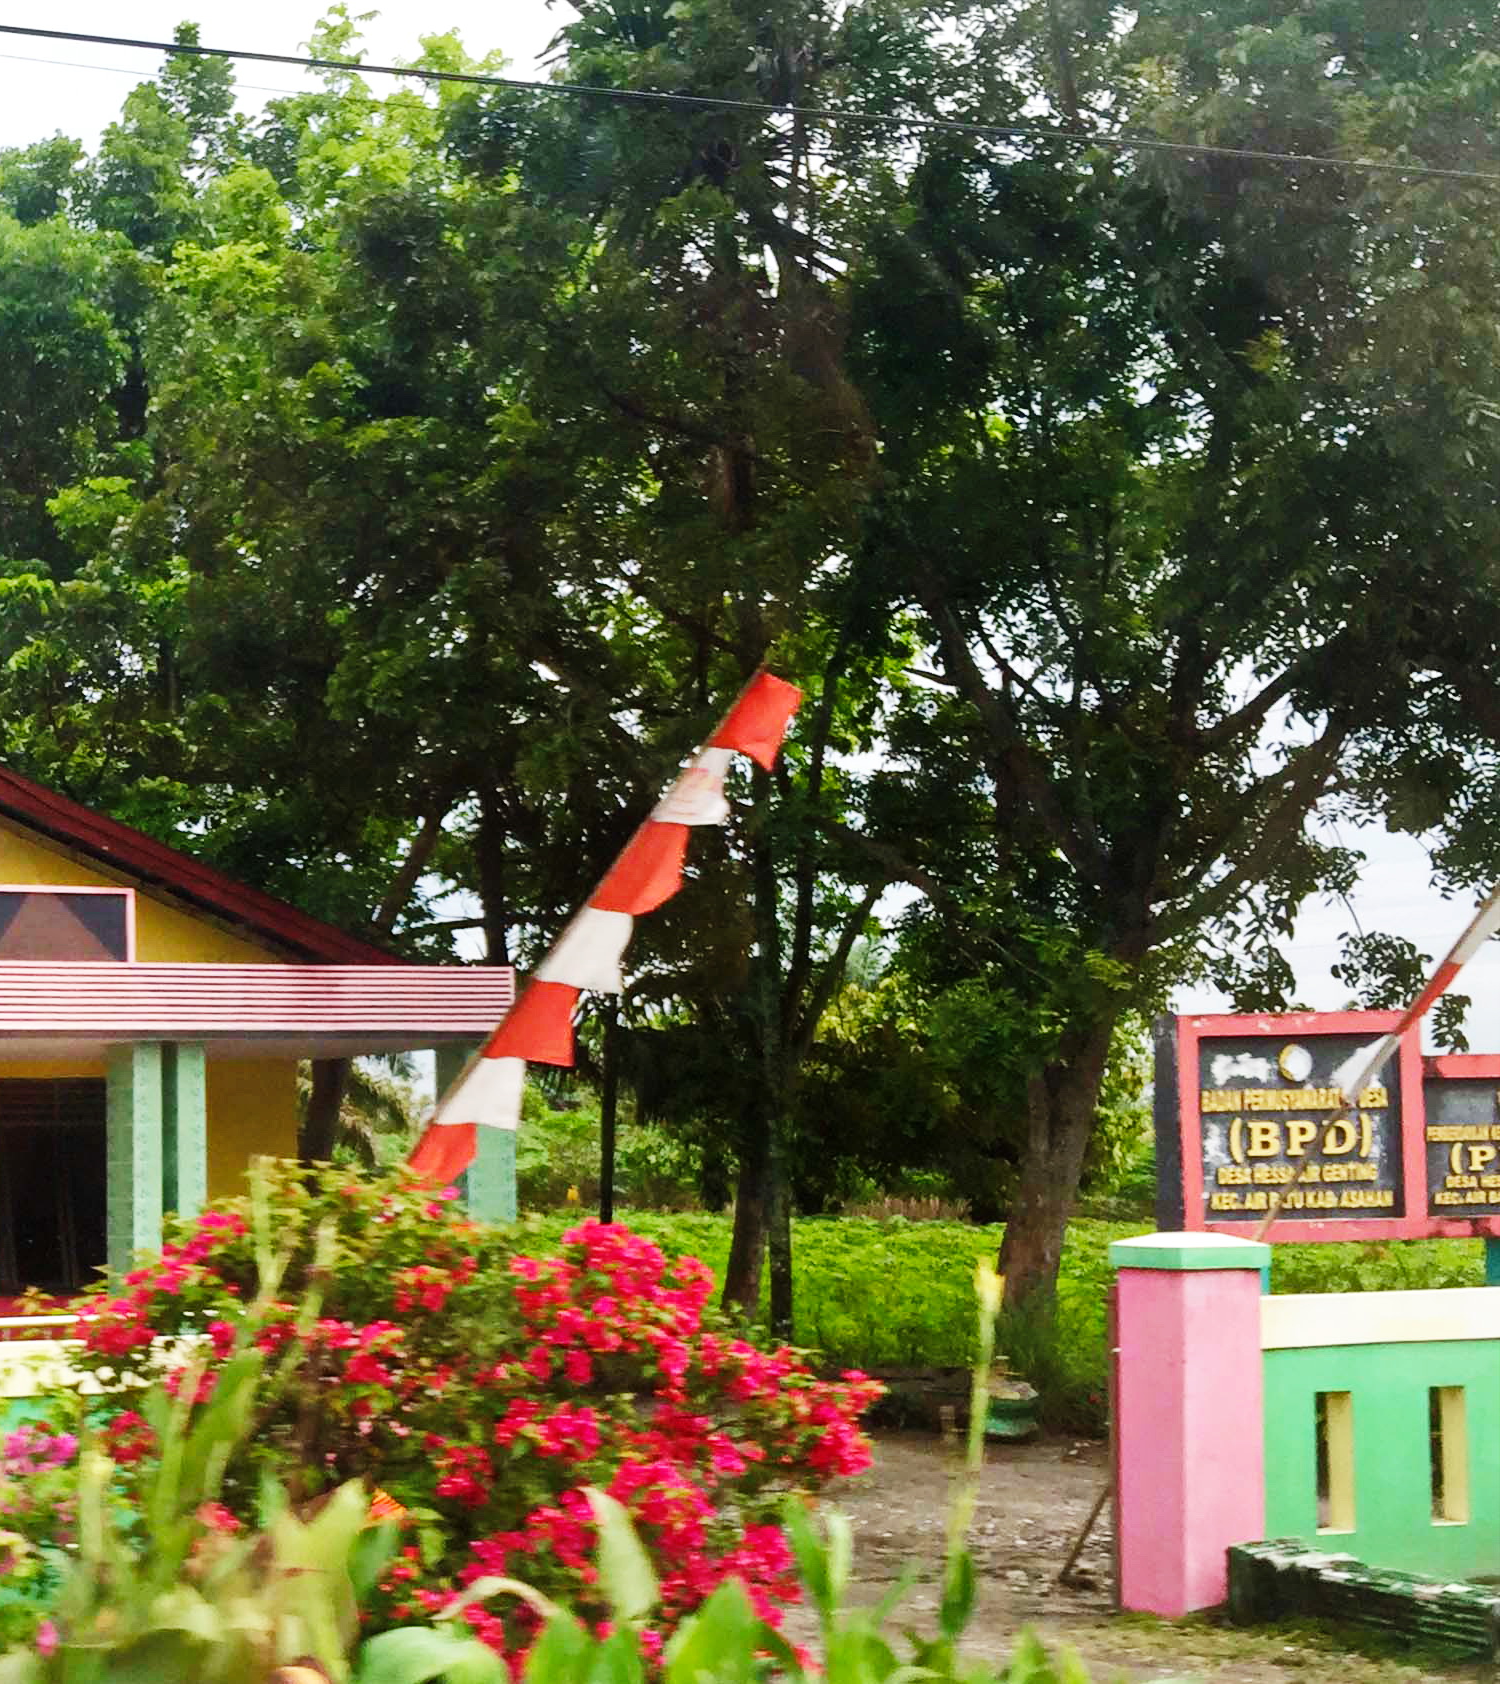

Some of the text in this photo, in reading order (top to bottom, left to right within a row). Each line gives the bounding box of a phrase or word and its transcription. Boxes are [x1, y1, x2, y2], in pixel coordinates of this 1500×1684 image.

[1201, 1090, 1242, 1112] BADAN
[1230, 1112, 1373, 1164] (BPD)
[1217, 1167, 1252, 1185] DESA
[1322, 1162, 1378, 1182] GENTING
[1445, 1174, 1478, 1189] DESA
[1244, 1191, 1268, 1210] AIR
[1340, 1189, 1394, 1208] ASAHAN
